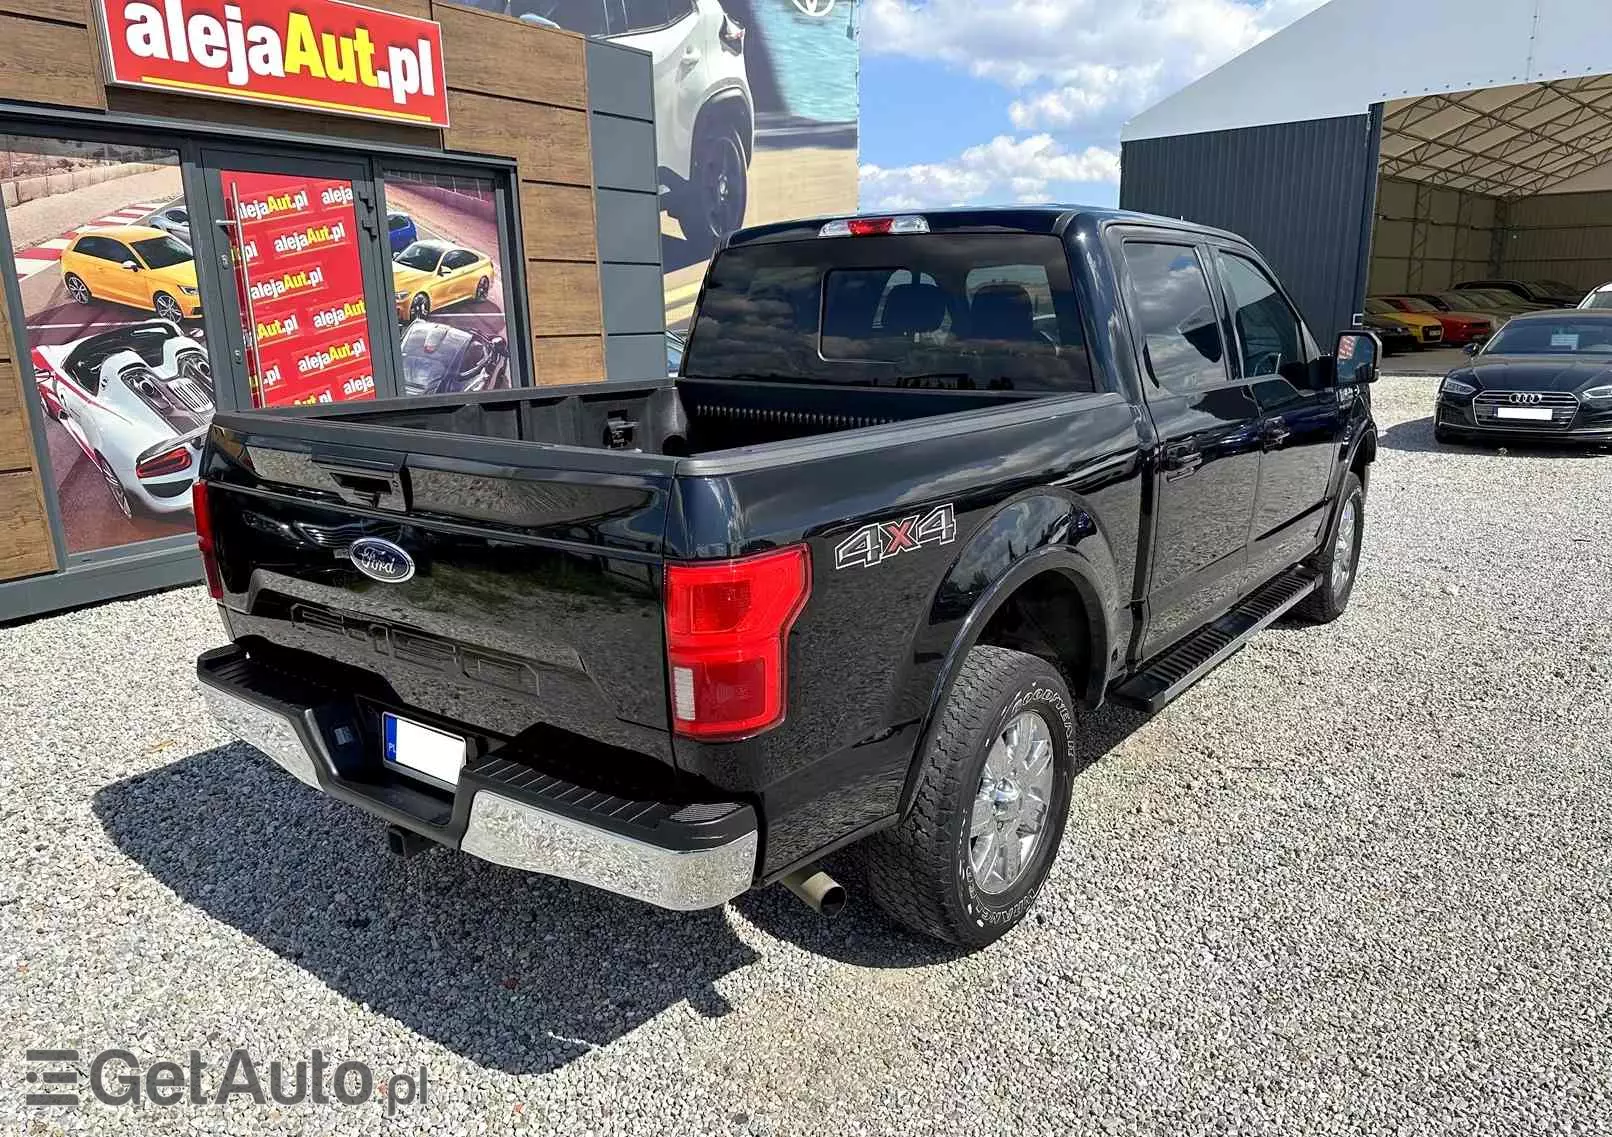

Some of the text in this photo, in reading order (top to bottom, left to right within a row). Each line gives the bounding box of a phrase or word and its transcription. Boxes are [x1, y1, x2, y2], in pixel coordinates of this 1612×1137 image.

[123, 0, 435, 105] alejaAut.pl
[274, 222, 346, 253] alejaAut.pl
[250, 266, 324, 301] alejaAut.pl
[297, 338, 366, 374] alejaAut.pl
[387, 742, 397, 753] PL
